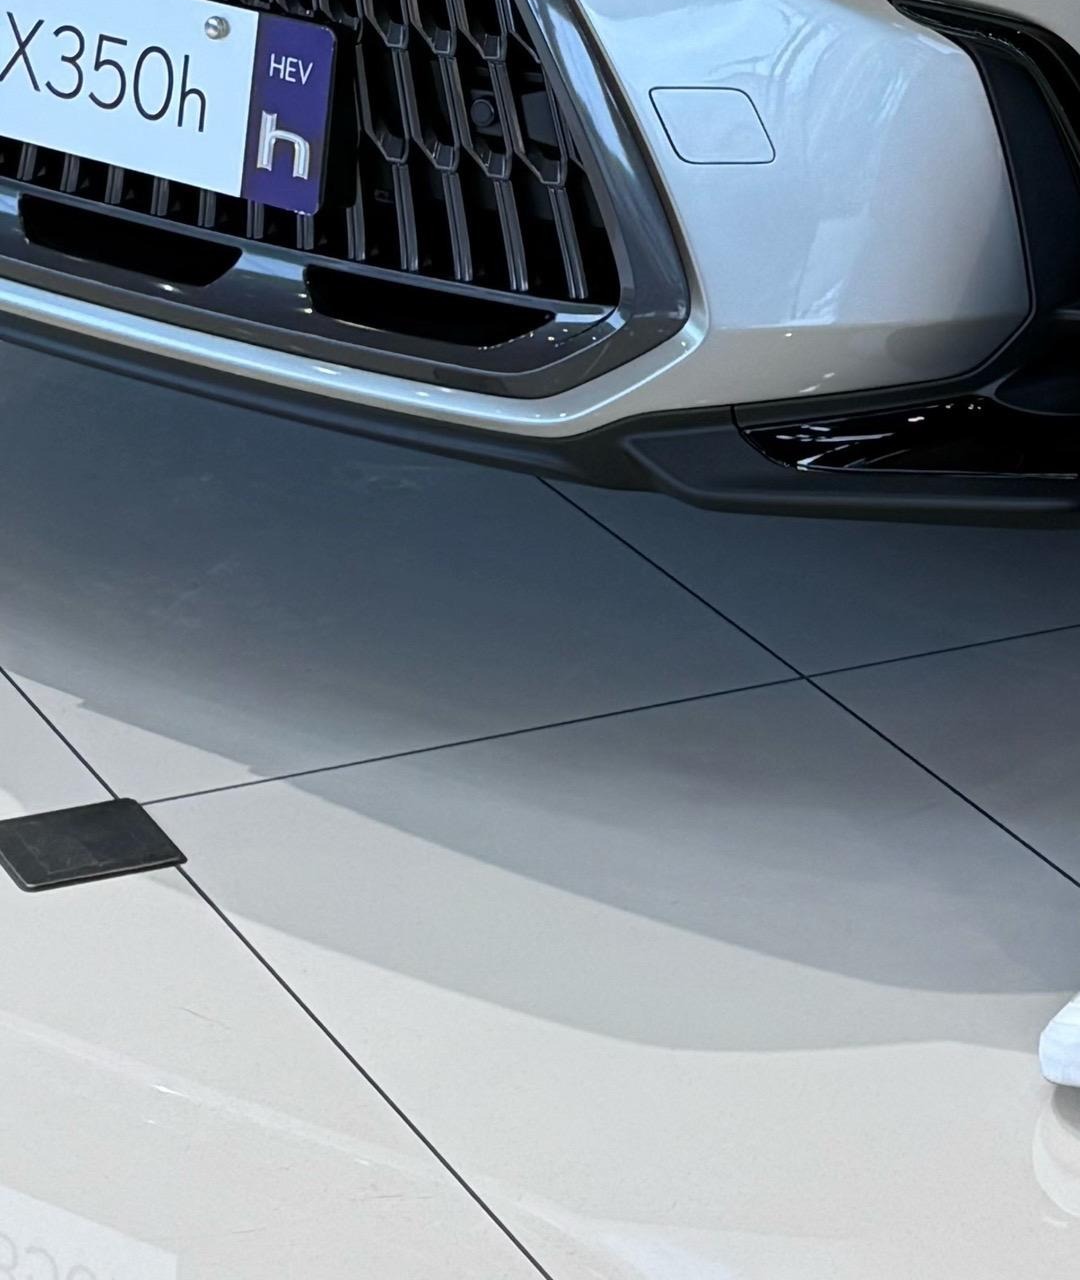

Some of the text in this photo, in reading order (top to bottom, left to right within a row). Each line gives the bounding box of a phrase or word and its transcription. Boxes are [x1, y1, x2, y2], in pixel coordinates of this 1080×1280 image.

[0, 11, 206, 133] X350h
[269, 53, 313, 85] HEV
[256, 109, 310, 180] h
